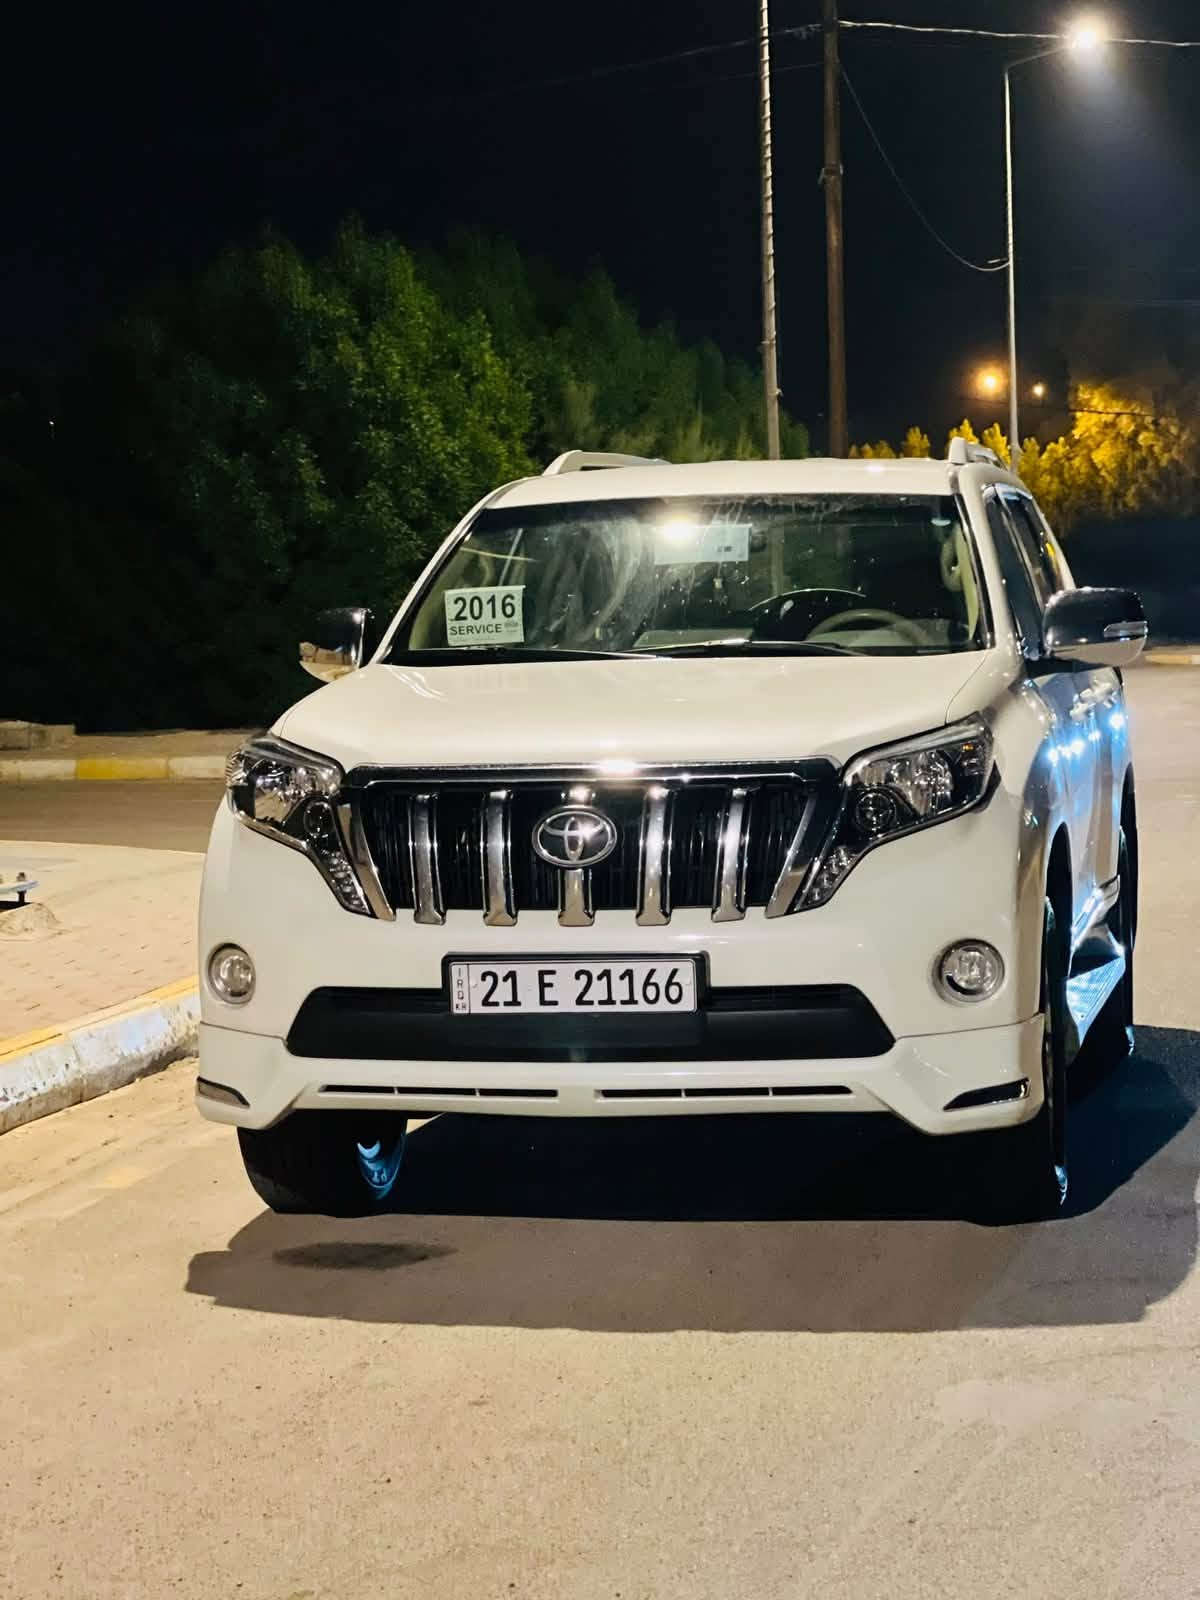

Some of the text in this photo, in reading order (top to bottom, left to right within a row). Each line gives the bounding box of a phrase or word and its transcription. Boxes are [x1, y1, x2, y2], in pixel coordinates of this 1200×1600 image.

[454, 594, 516, 621] 2016
[449, 624, 502, 636] SERVICE
[481, 968, 683, 1007] 21 E 21166
